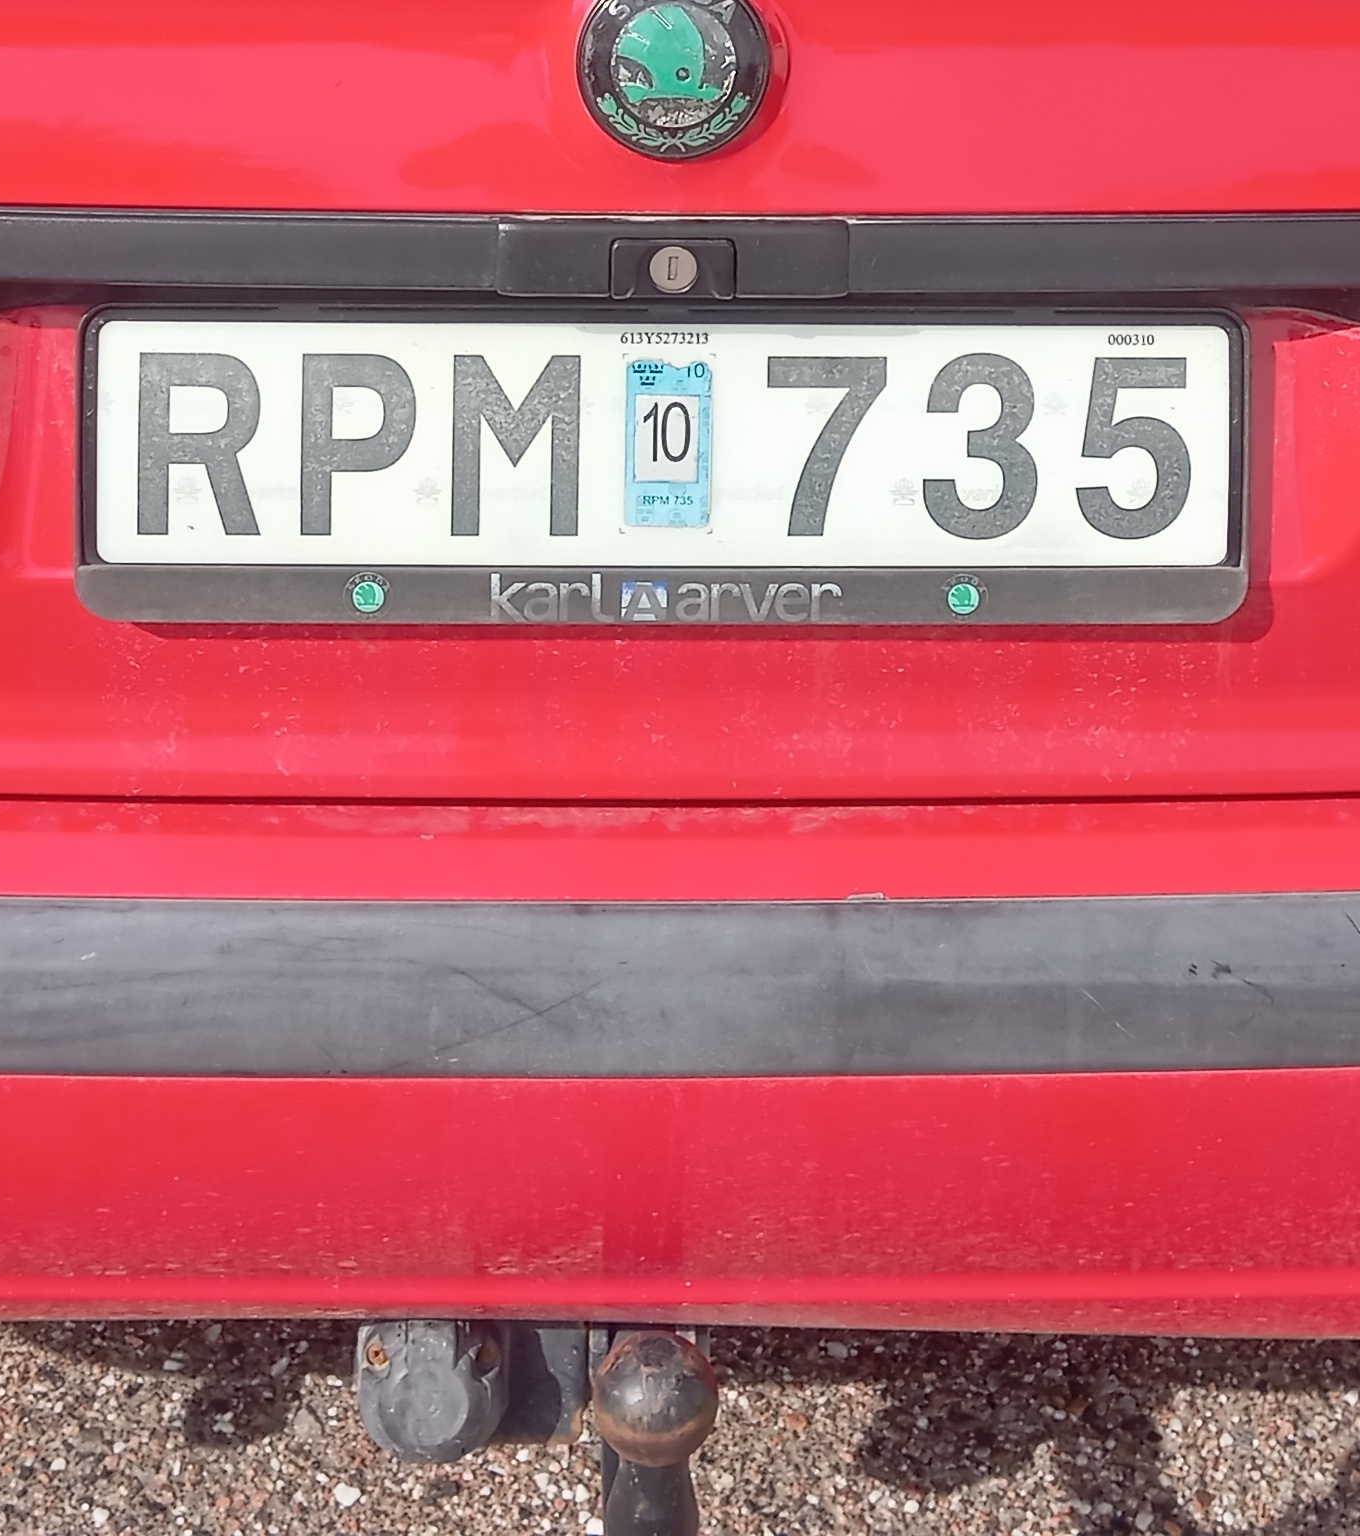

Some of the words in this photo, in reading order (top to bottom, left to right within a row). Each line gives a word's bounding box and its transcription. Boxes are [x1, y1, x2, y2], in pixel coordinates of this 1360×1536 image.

[621, 332, 709, 345] 613Y5273213
[1108, 334, 1155, 345] 000310
[136, 353, 581, 536] RPM
[767, 355, 1192, 539] 735
[643, 402, 691, 462] 10
[643, 496, 670, 506] RPM
[674, 497, 694, 506] 735
[489, 572, 616, 623] karl
[675, 581, 842, 623] arver
